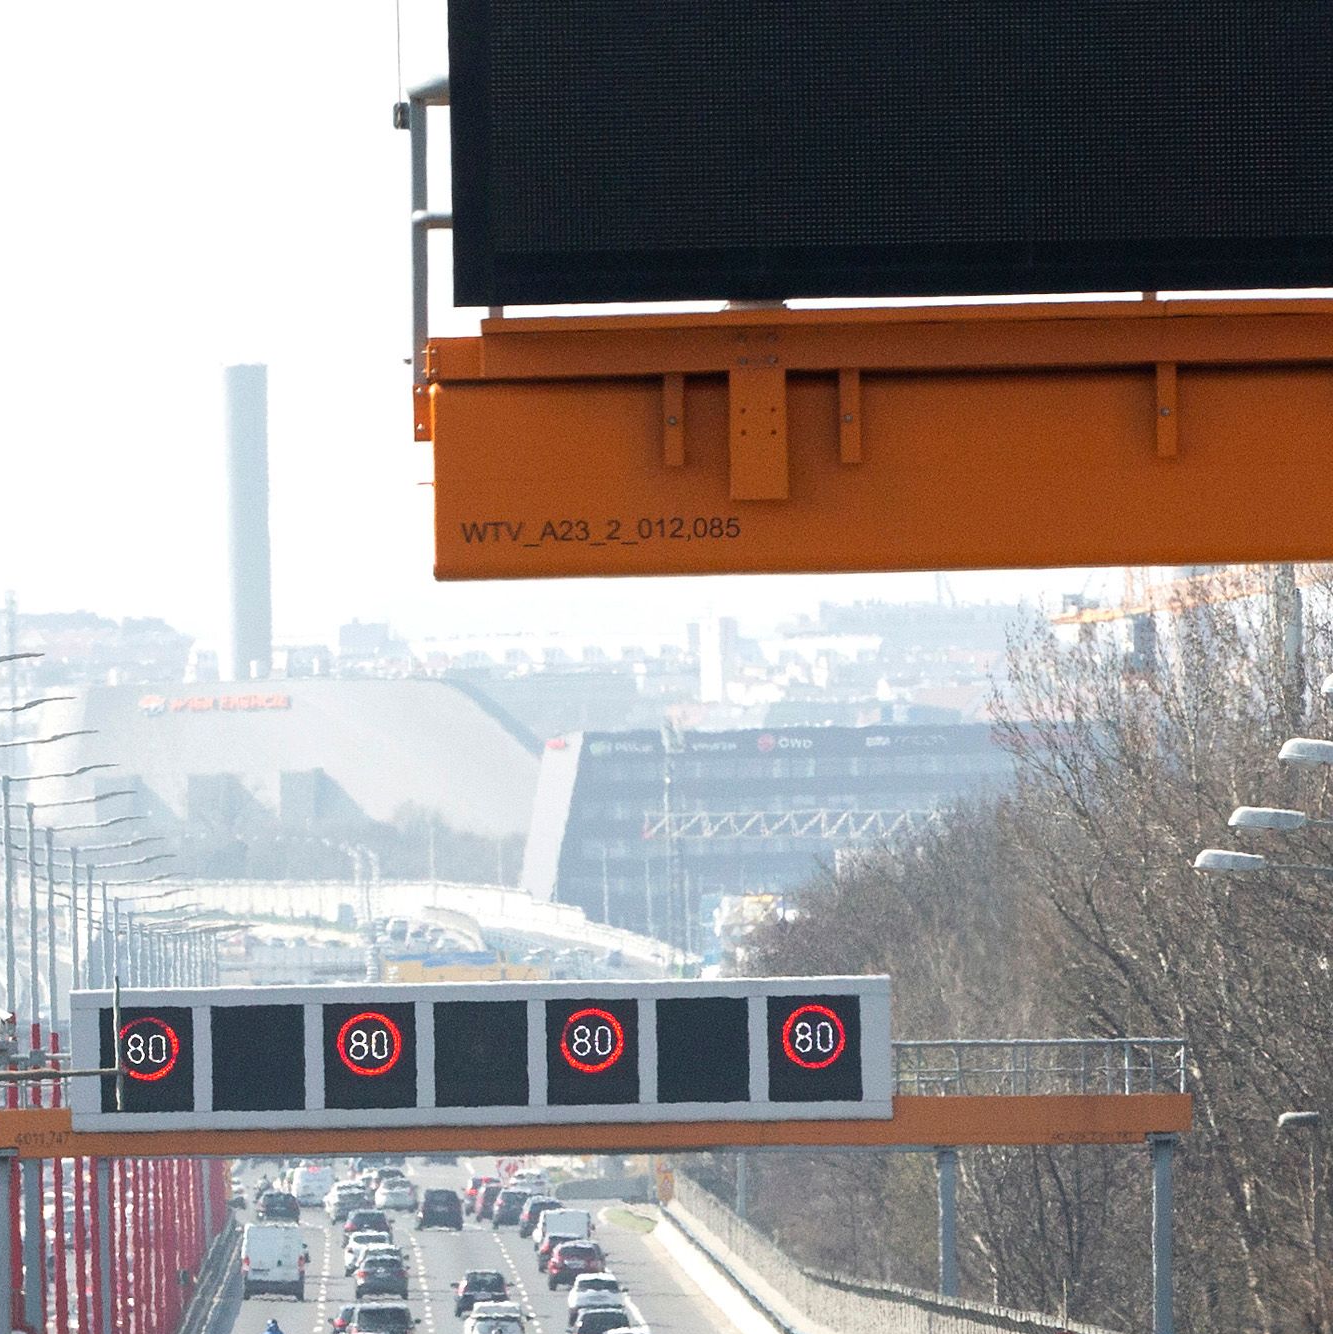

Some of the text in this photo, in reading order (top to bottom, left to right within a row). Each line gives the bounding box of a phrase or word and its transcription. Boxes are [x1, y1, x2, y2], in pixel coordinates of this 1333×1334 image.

[460, 516, 742, 548] WTV_A23_2_012,085
[127, 1034, 168, 1065] 80
[349, 1029, 389, 1060] 80
[572, 1025, 612, 1057] 80
[795, 1022, 835, 1054] 80
